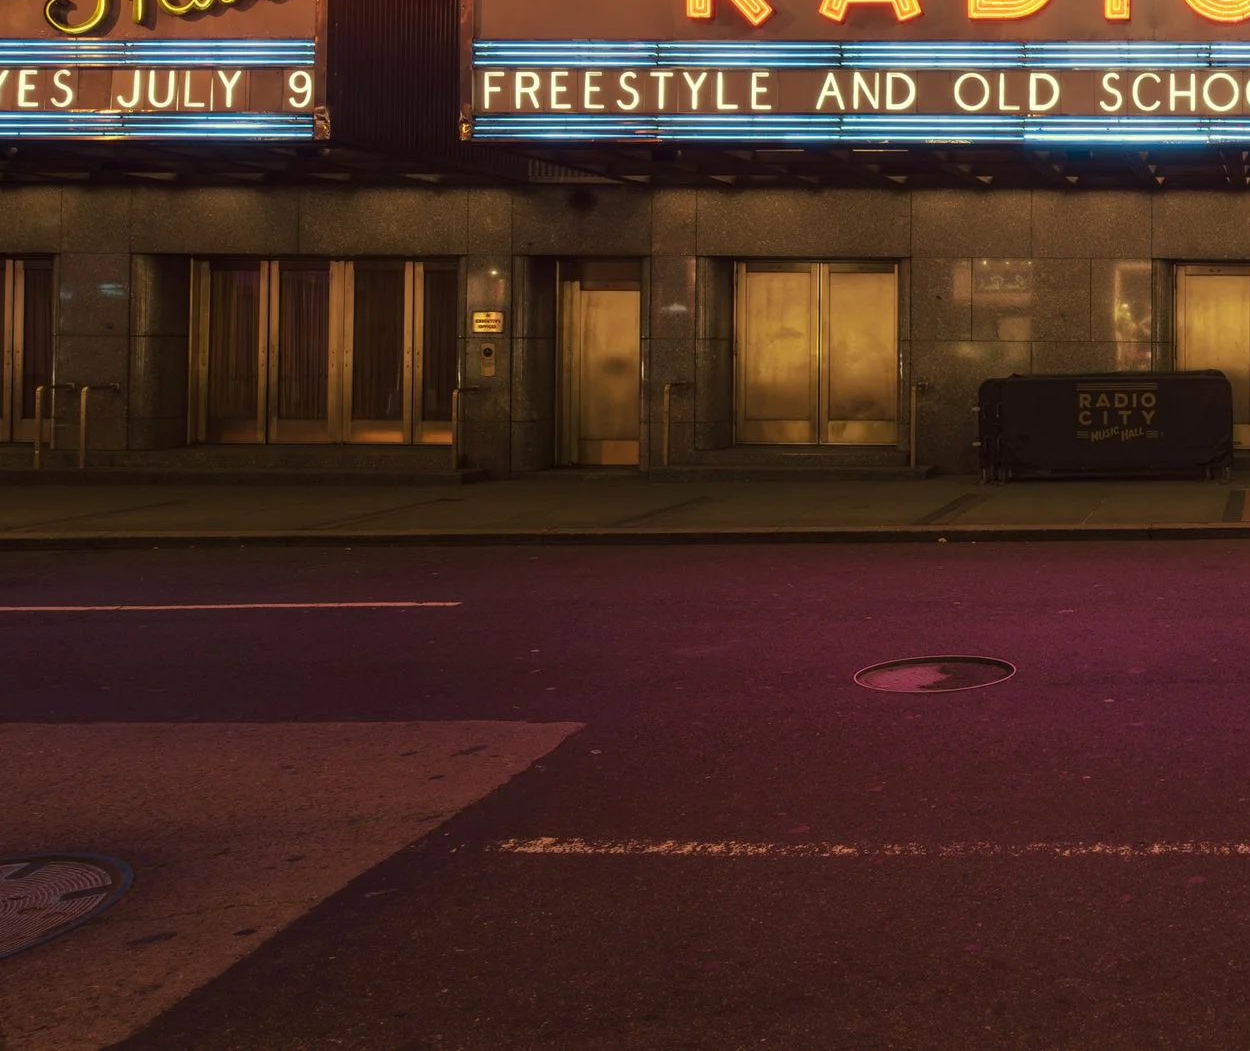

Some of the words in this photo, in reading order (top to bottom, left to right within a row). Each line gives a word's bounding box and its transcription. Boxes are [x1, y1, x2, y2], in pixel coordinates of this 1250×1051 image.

[117, 70, 242, 108] JULY
[289, 70, 313, 108] 9
[484, 72, 772, 110] FREESTYLE
[816, 72, 916, 110] AND
[954, 72, 1060, 111] OLD
[1078, 392, 1156, 408] RADIO
[1078, 410, 1156, 426] CITY
[1090, 426, 1120, 443] MUSIC
[1121, 427, 1144, 442] HALL
